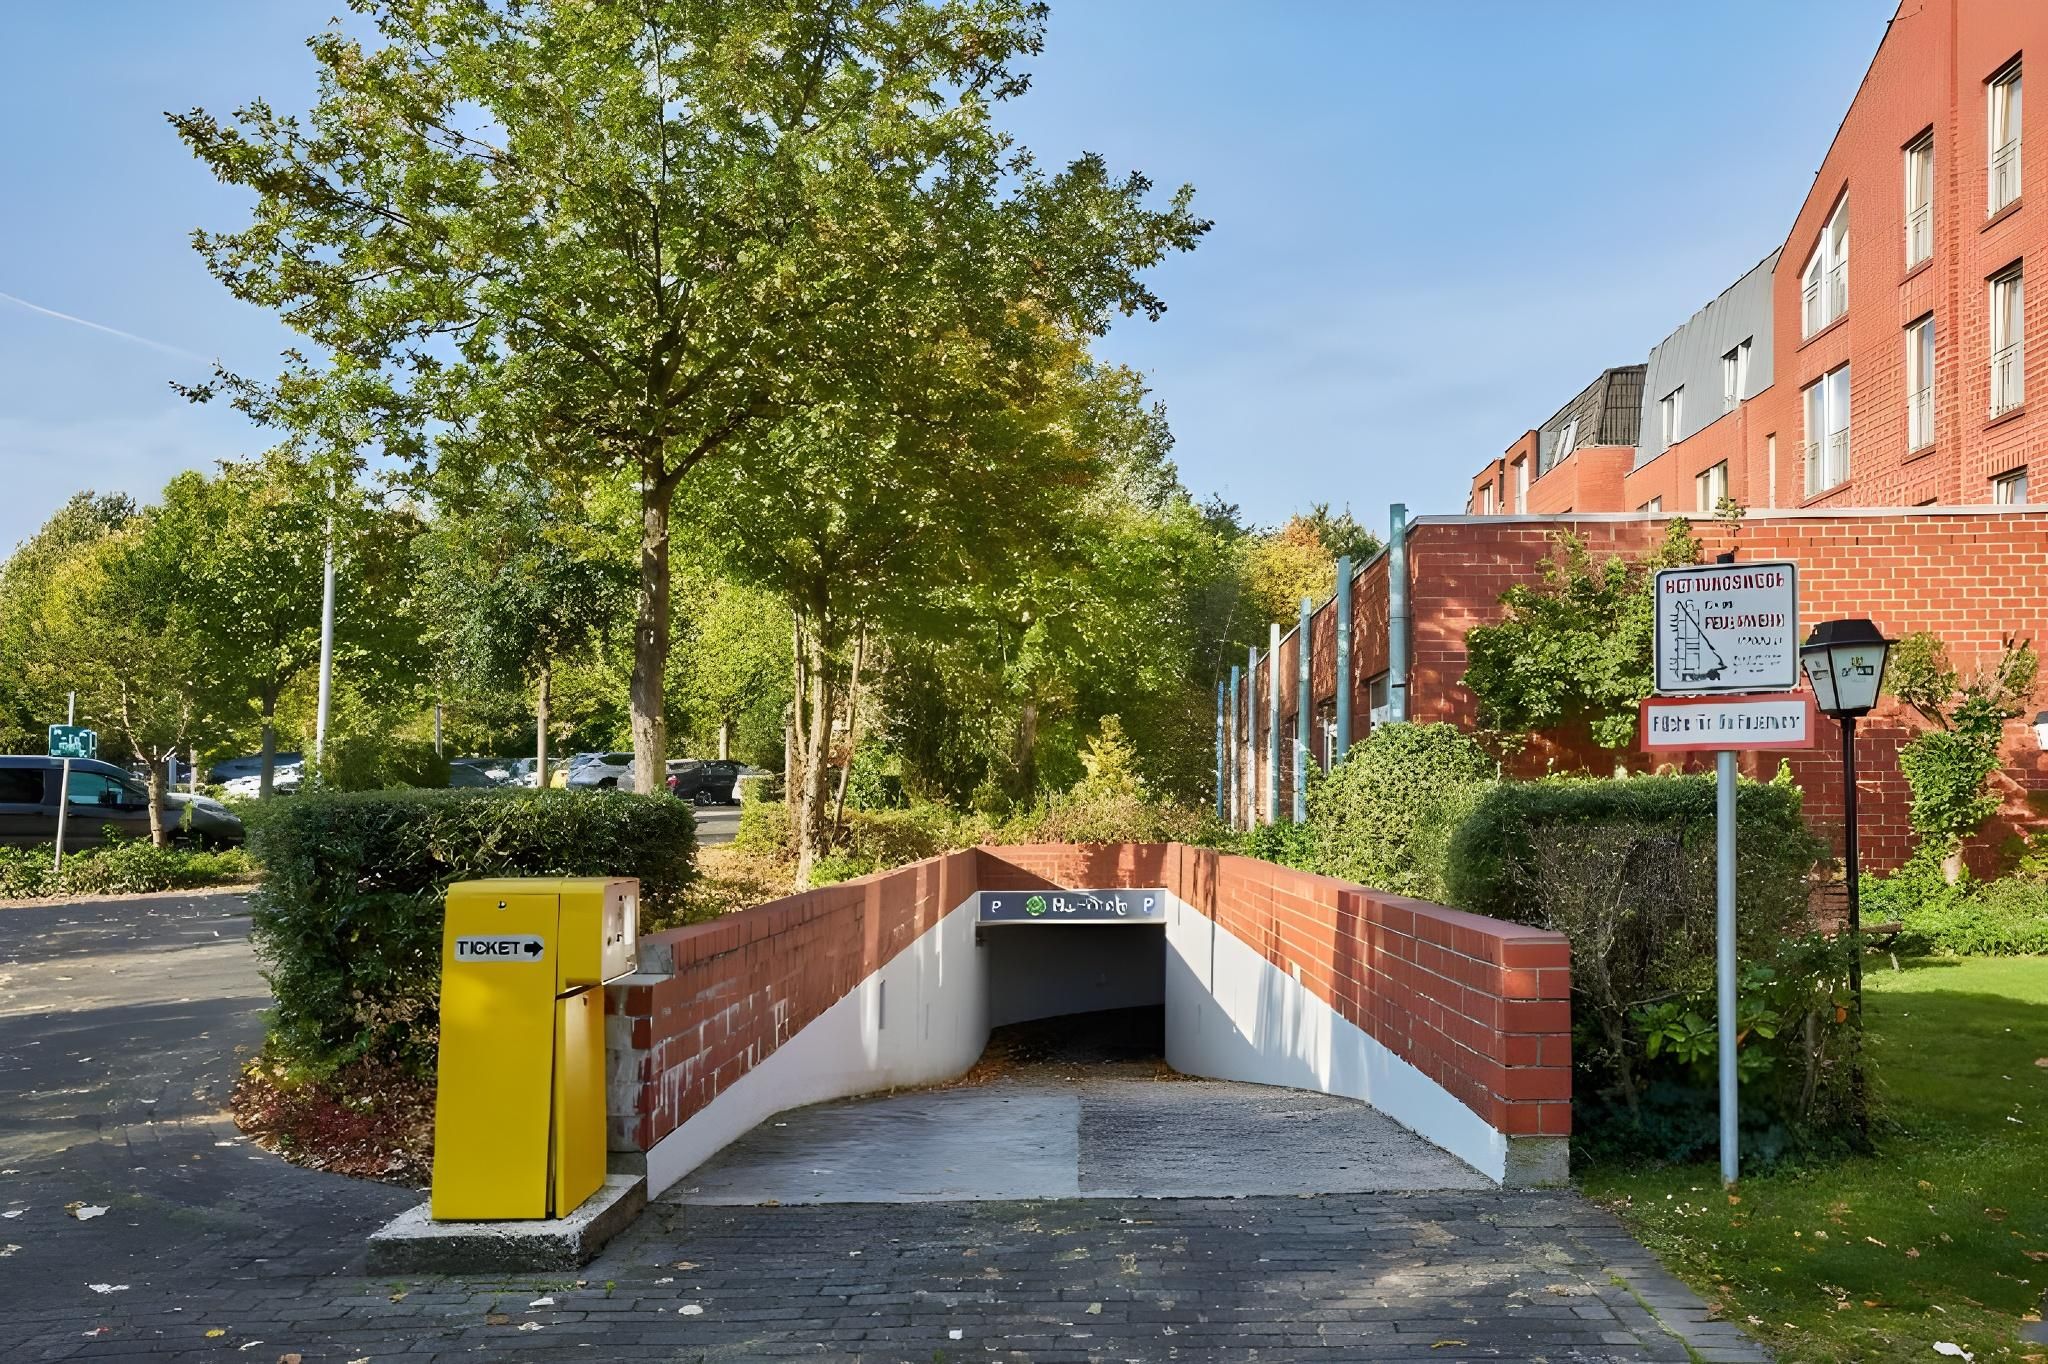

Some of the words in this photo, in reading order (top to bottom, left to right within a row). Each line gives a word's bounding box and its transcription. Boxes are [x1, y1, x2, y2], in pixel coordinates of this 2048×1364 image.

[992, 900, 1002, 913] P
[1143, 897, 1154, 913] P
[456, 941, 521, 955] TICKET
